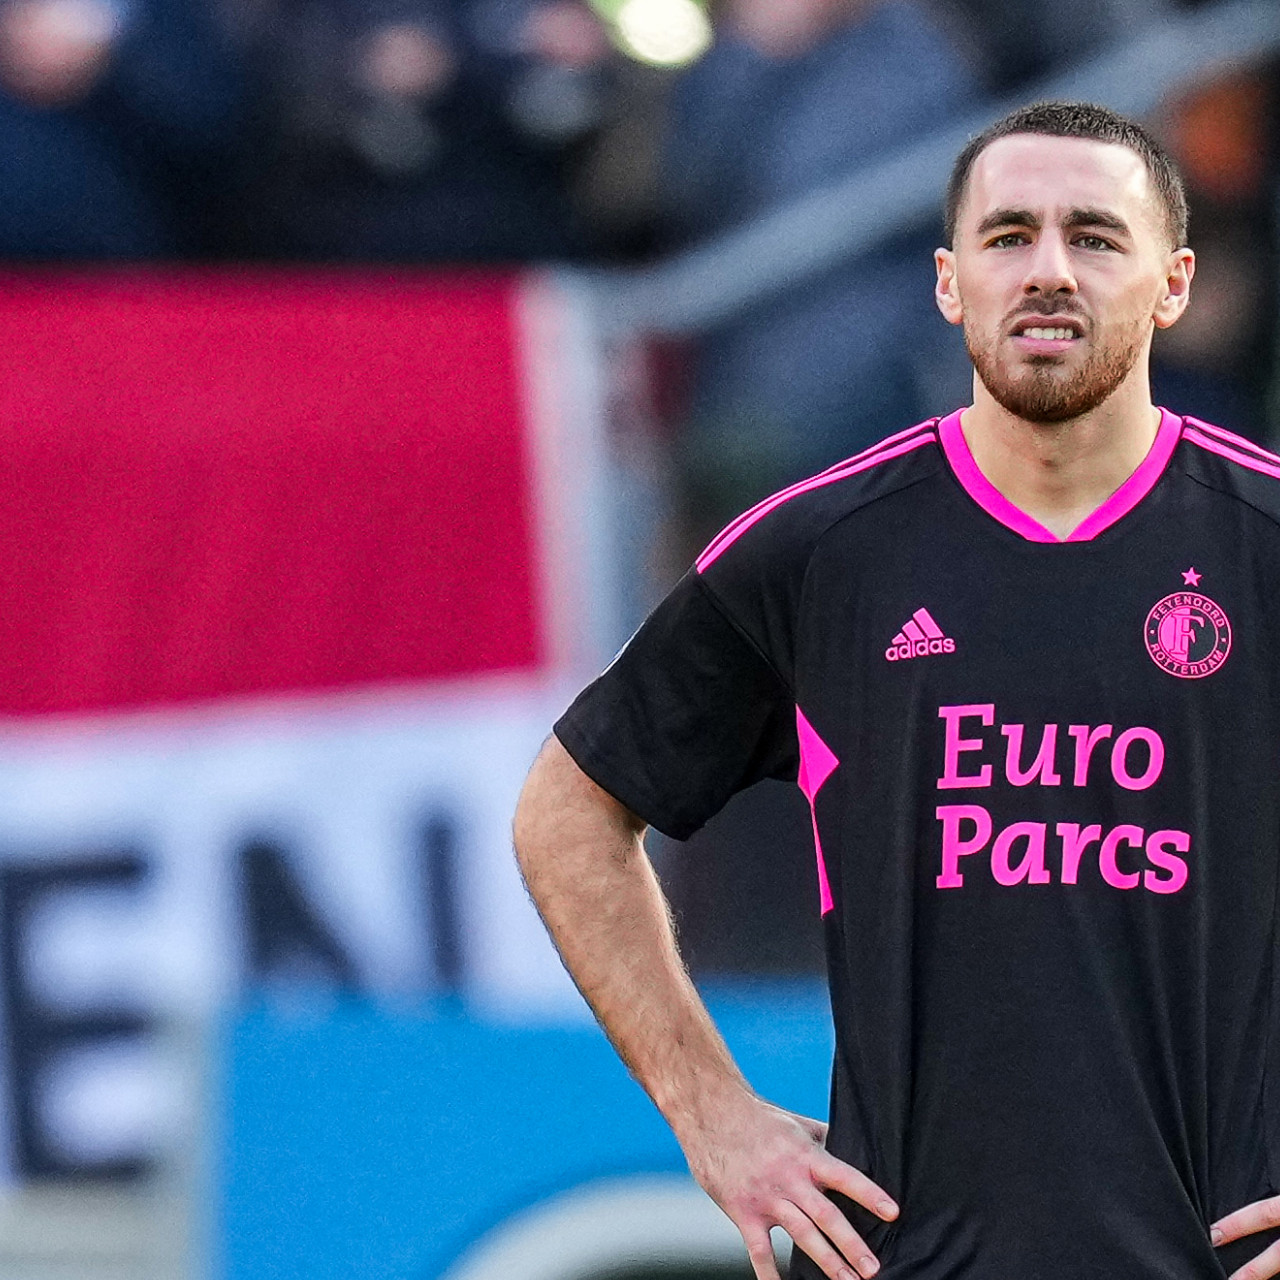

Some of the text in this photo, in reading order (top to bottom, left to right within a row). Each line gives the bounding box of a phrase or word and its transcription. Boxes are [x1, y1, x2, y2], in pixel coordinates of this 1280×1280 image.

[1152, 596, 1225, 628] FEYENOORD
[885, 637, 956, 661] adidas
[1150, 643, 1224, 675] ROTTERDAM
[936, 703, 1165, 791] Euro
[935, 804, 1191, 894] Parcs
